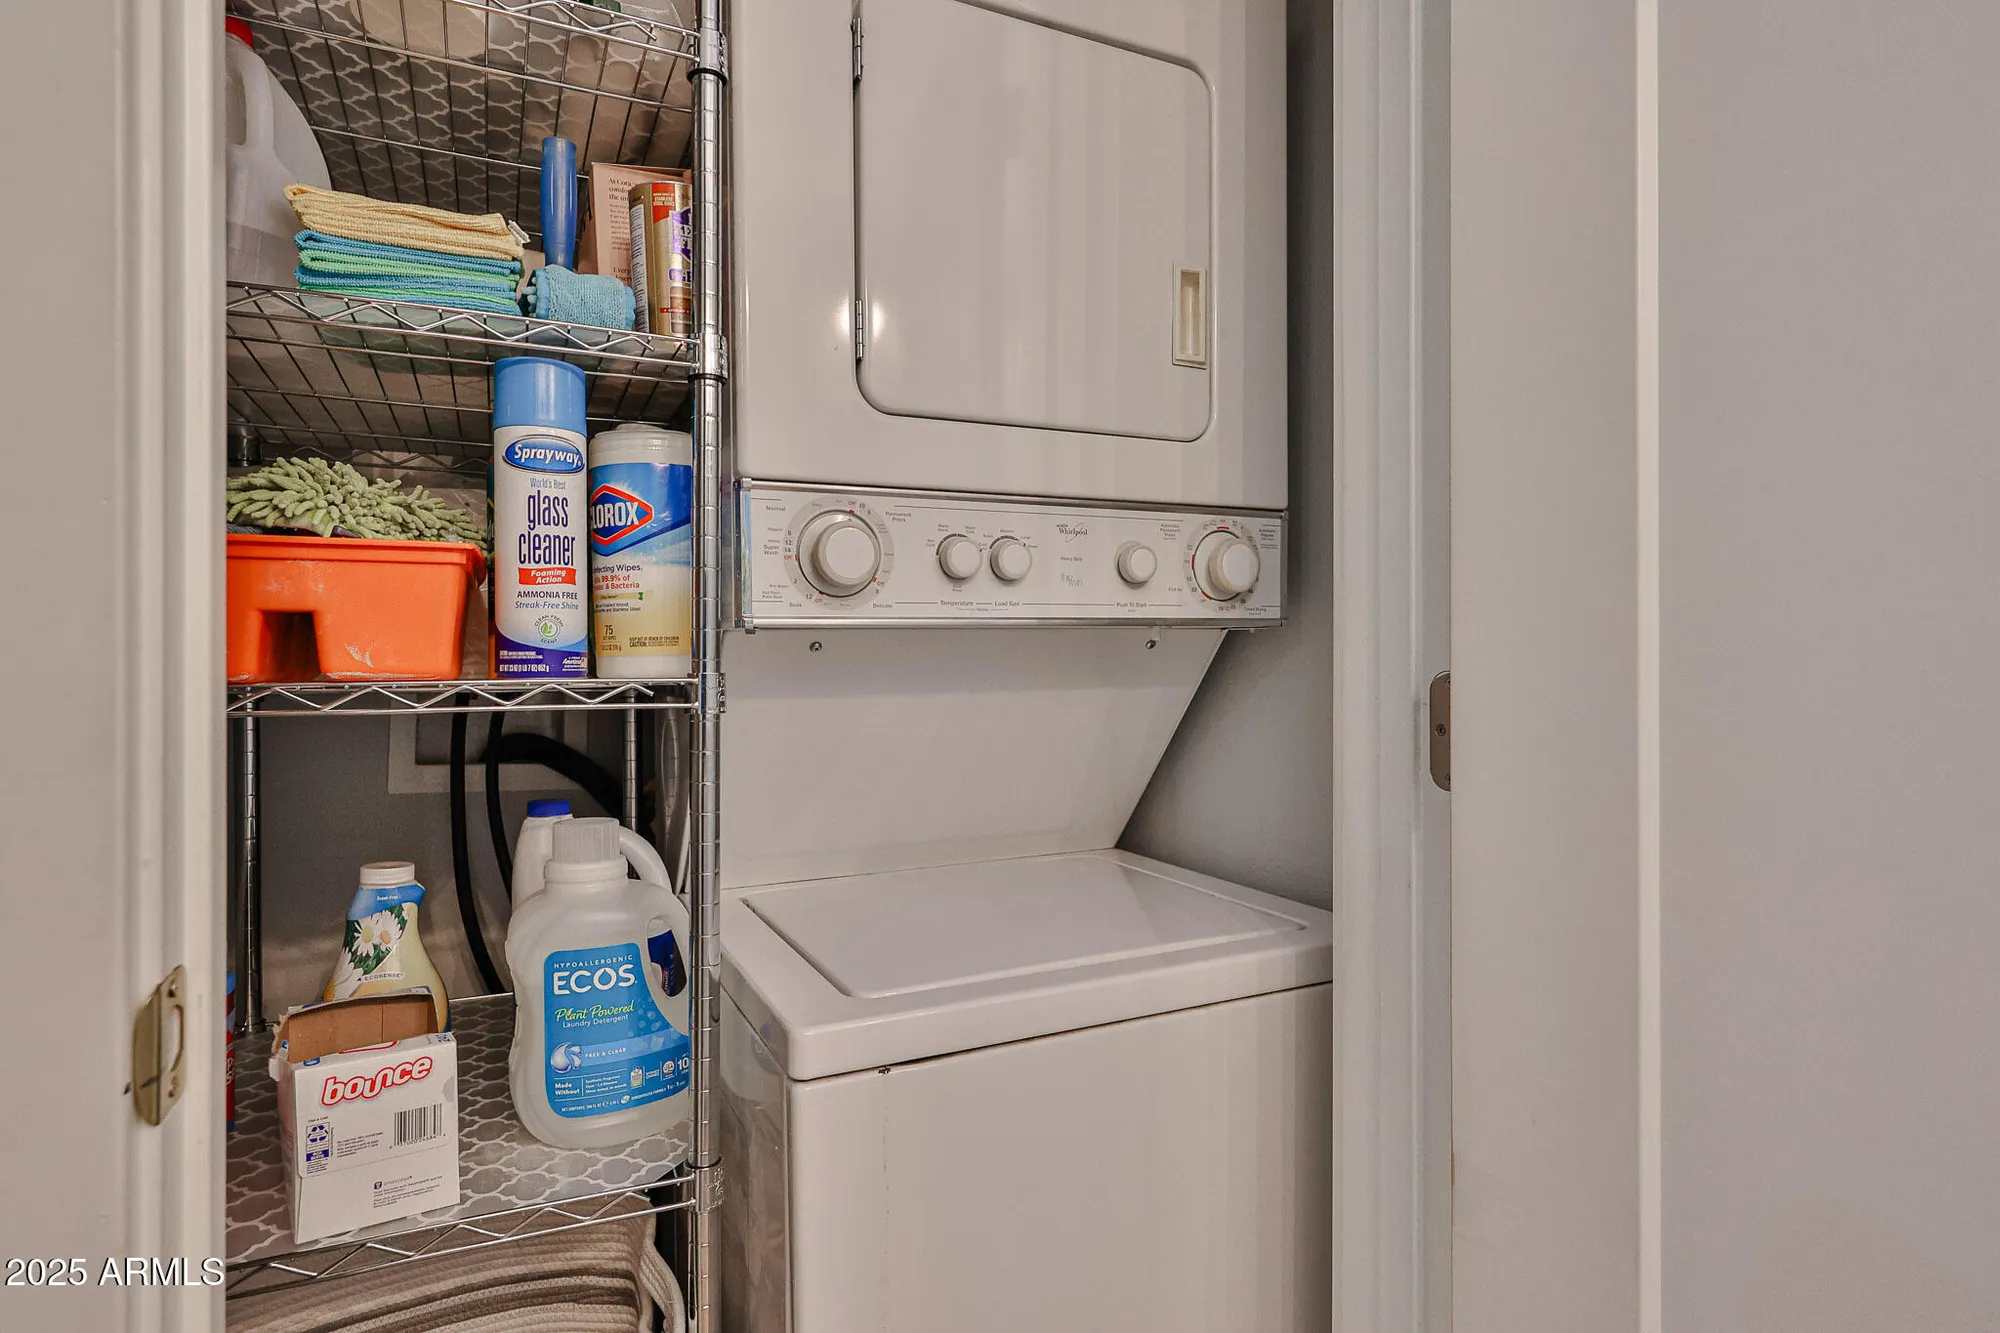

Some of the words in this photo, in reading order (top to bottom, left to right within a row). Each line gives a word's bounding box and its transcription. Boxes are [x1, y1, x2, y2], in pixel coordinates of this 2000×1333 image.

[514, 443, 580, 468] Sprayway
[530, 477, 553, 489] World's
[553, 478, 567, 490] Best
[527, 489, 569, 531] glass
[591, 501, 640, 529] LOROX
[518, 530, 576, 566] cleaner
[530, 568, 567, 577] Foaming
[622, 573, 631, 581] of
[535, 576, 563, 584] Action
[611, 582, 640, 590] Bacteria
[516, 590, 561, 599] AMMONIA
[561, 591, 579, 600] FREE
[514, 600, 561, 610] Streak-Free
[561, 601, 580, 611] Shine
[940, 600, 974, 608] Temperature
[603, 624, 615, 636] 75
[553, 954, 634, 969] HYPOALLERGENIC
[553, 963, 636, 995] ECOS
[554, 1005, 588, 1022] Plant
[590, 999, 635, 1019] Powered
[562, 1018, 591, 1029] Laundry
[593, 1013, 630, 1026] Detergent
[607, 1047, 627, 1056] CLEAR
[321, 1056, 433, 1106] bounce
[554, 1088, 580, 1097] Without
